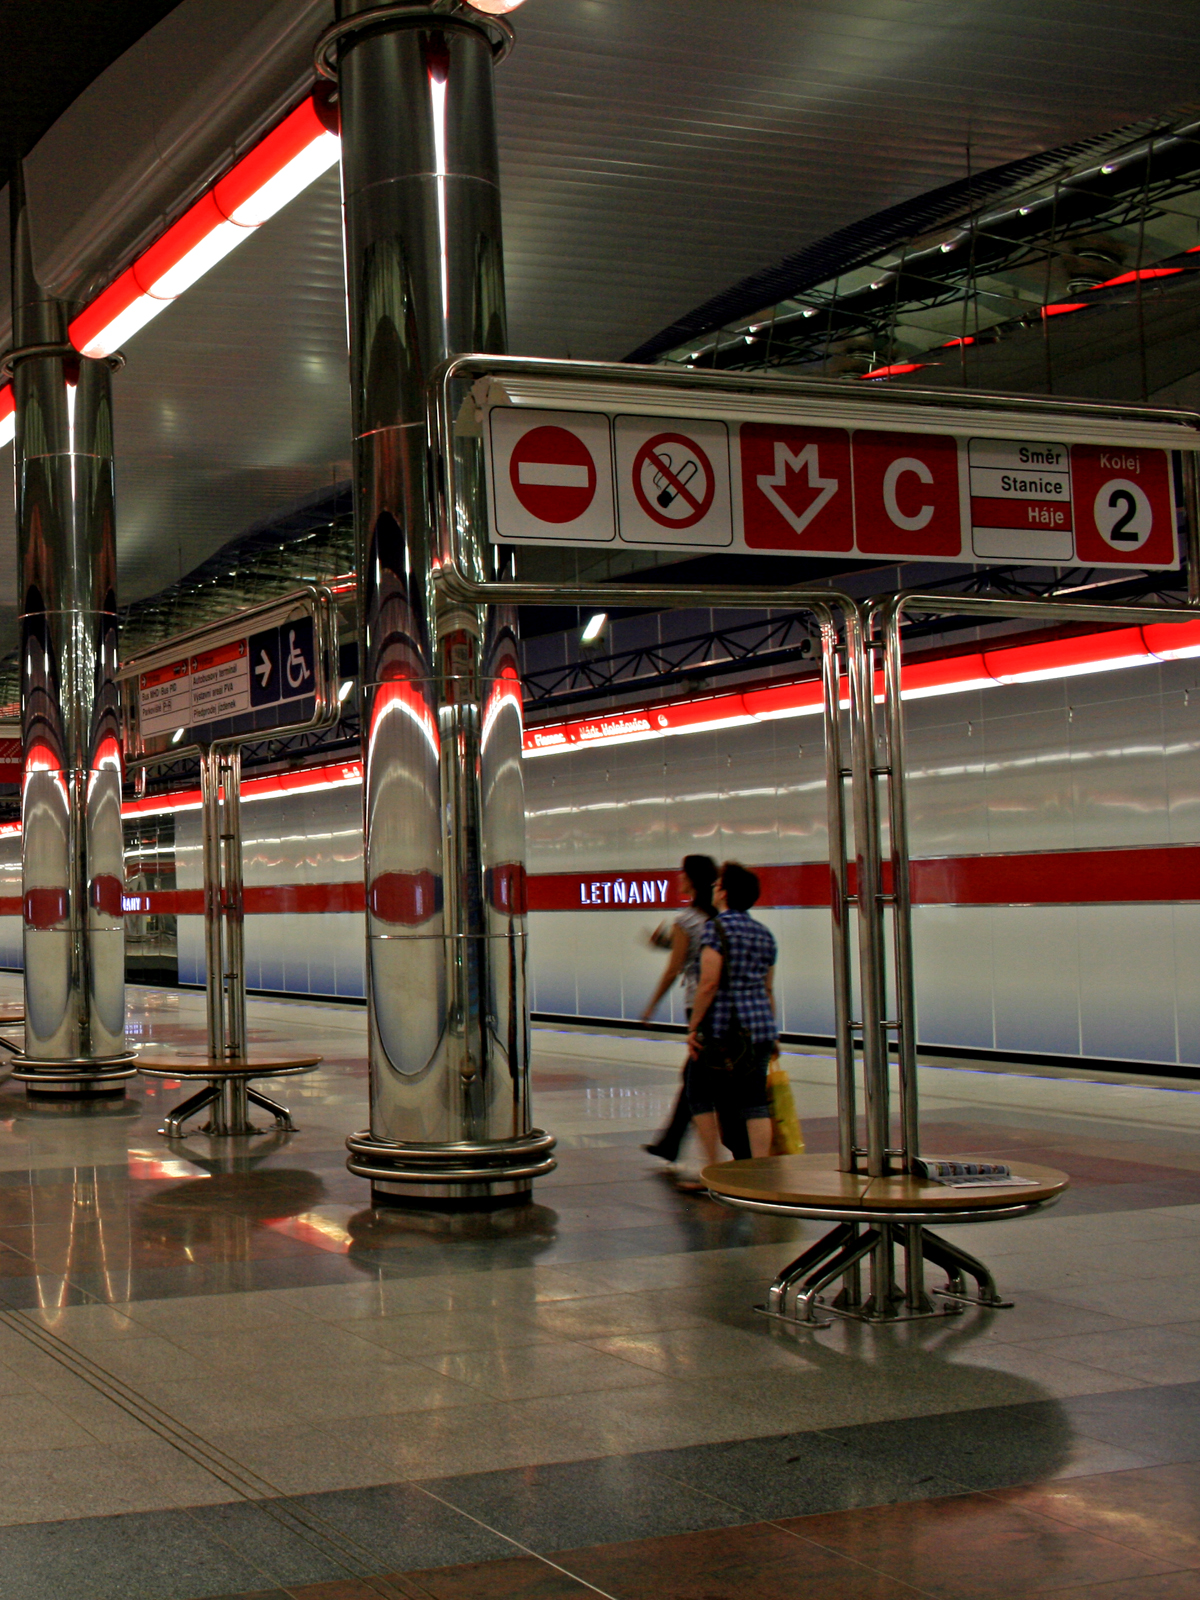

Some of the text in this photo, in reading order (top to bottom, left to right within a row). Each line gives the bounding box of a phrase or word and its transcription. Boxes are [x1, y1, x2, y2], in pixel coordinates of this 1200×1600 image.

[1019, 447, 1062, 465] Směr
[1100, 453, 1140, 474] Kolej
[883, 457, 935, 531] C
[1001, 475, 1063, 494] Stanice
[1028, 506, 1064, 527] Háje
[1108, 489, 1139, 542] 2
[580, 878, 669, 905] LETŇANY
